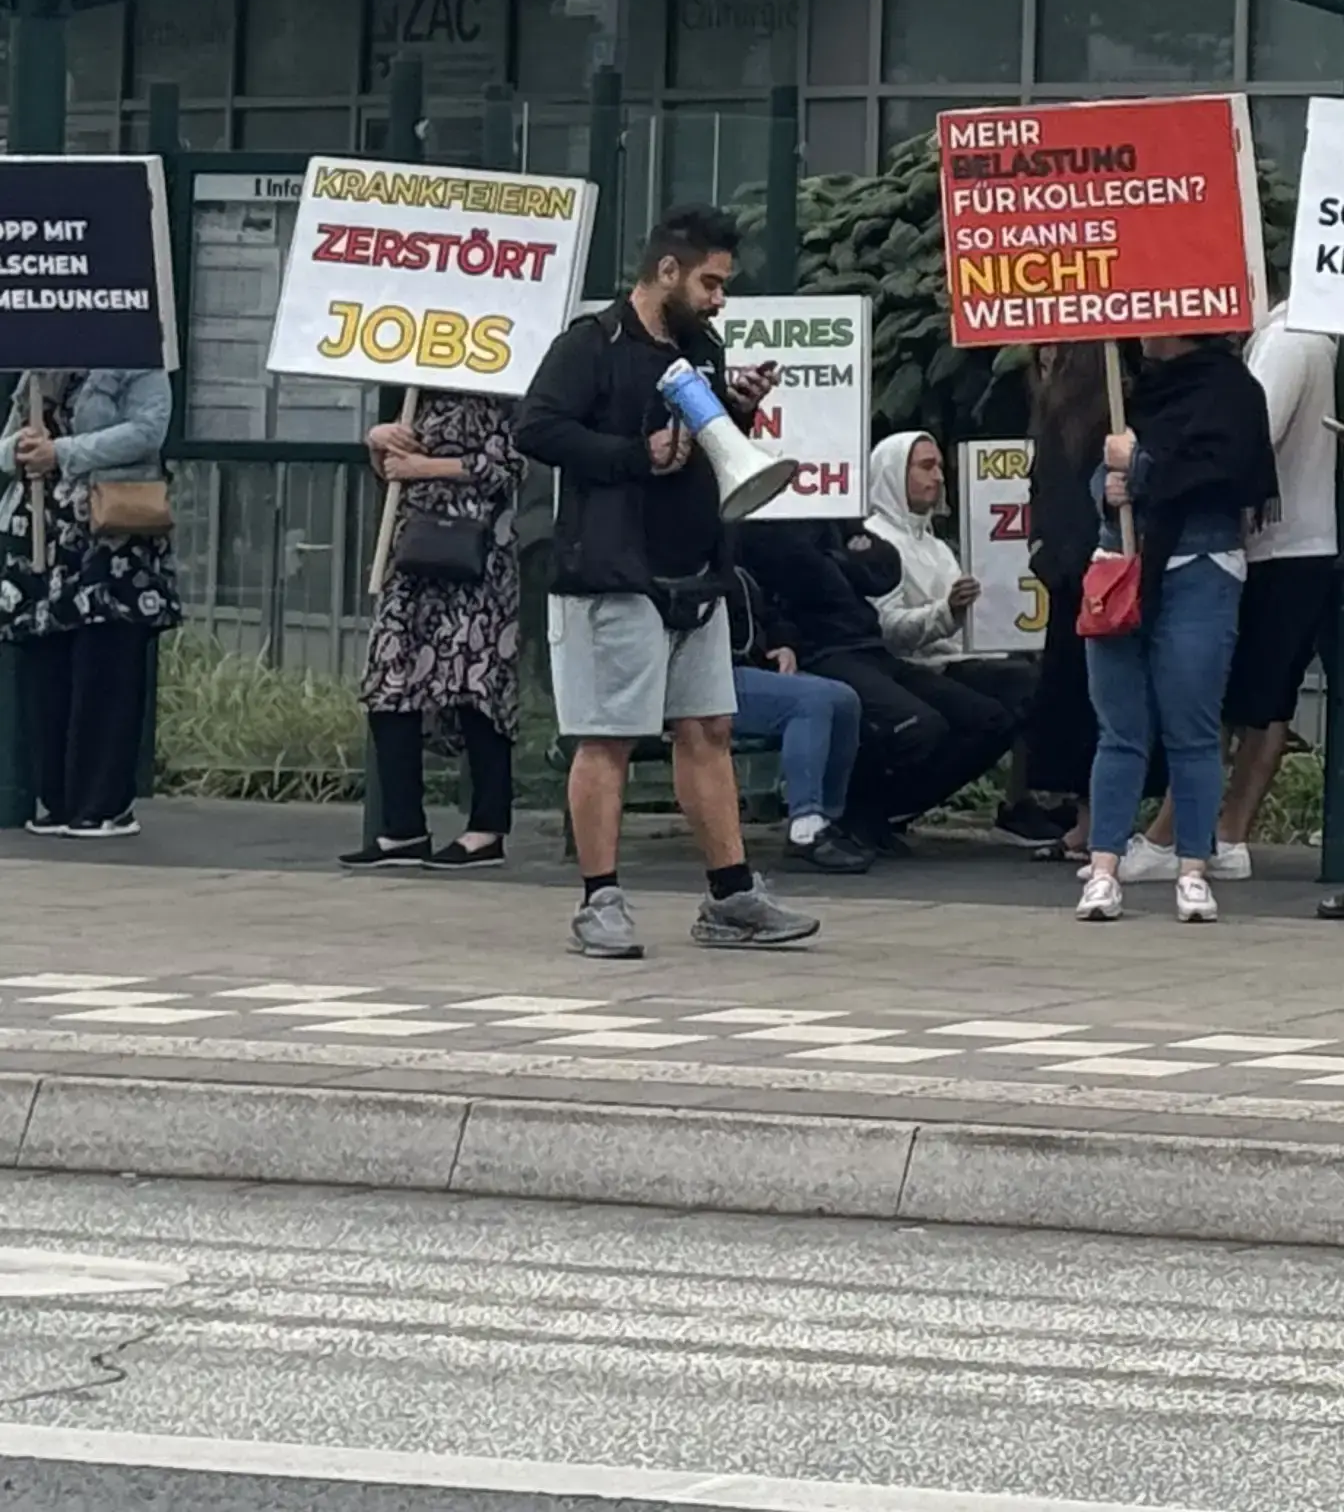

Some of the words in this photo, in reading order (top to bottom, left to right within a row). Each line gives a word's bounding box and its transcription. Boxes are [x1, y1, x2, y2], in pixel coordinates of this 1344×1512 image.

[950, 119, 1041, 149] MEHR
[952, 144, 1137, 180] BELASTUNG
[312, 165, 576, 220] KRANKFEIERN
[953, 179, 1016, 216] FÜR
[1023, 175, 1206, 212] KOLLEGEN?
[43, 220, 88, 242] MIT
[956, 227, 994, 251] SO
[1001, 220, 1078, 249] KANN
[1084, 219, 1117, 243] ES
[312, 223, 557, 283] ZERSTÖRT
[958, 247, 1119, 297] NICHT
[962, 286, 1240, 330] WEITERGEHEN!
[316, 299, 516, 374] JOBS
[724, 317, 855, 349] FAIRES
